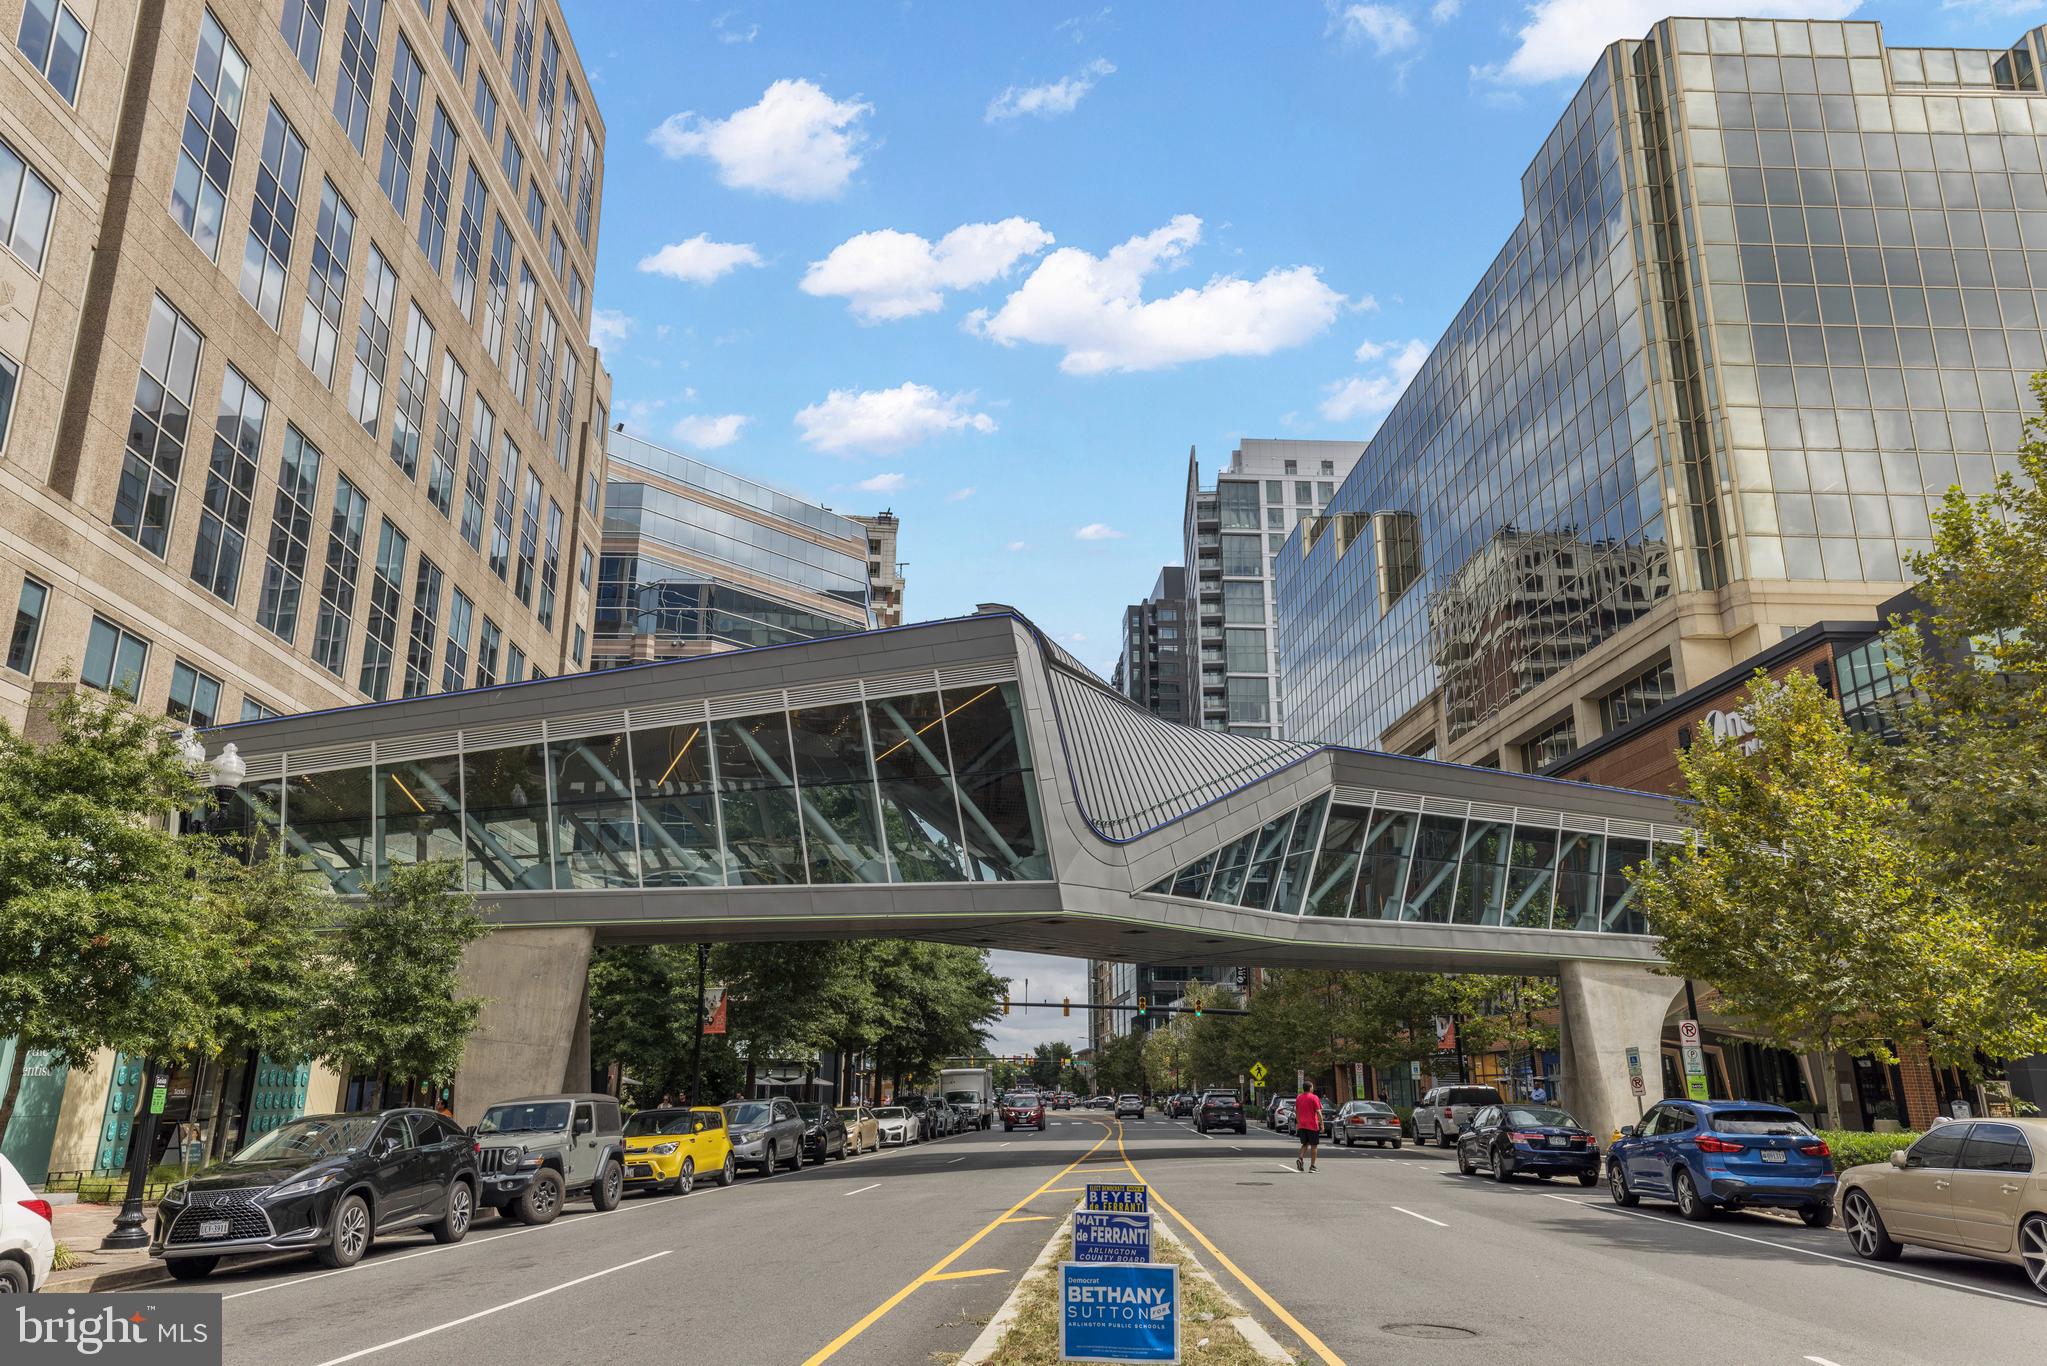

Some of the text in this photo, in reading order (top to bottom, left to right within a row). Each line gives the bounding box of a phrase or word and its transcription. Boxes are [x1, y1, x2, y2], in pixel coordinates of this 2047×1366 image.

[1089, 1191, 1144, 1204] BEYER
[1089, 1202, 1145, 1212] de FERRANTI
[1076, 1215, 1109, 1226] MATT
[1076, 1226, 1149, 1245] de FERRANTI
[1088, 1247, 1137, 1256] ARLINGTON
[1079, 1253, 1146, 1263] COUNTY BOARD
[1068, 1286, 1166, 1304] BETHANY
[1067, 1305, 1167, 1320] SUTTON FOR
